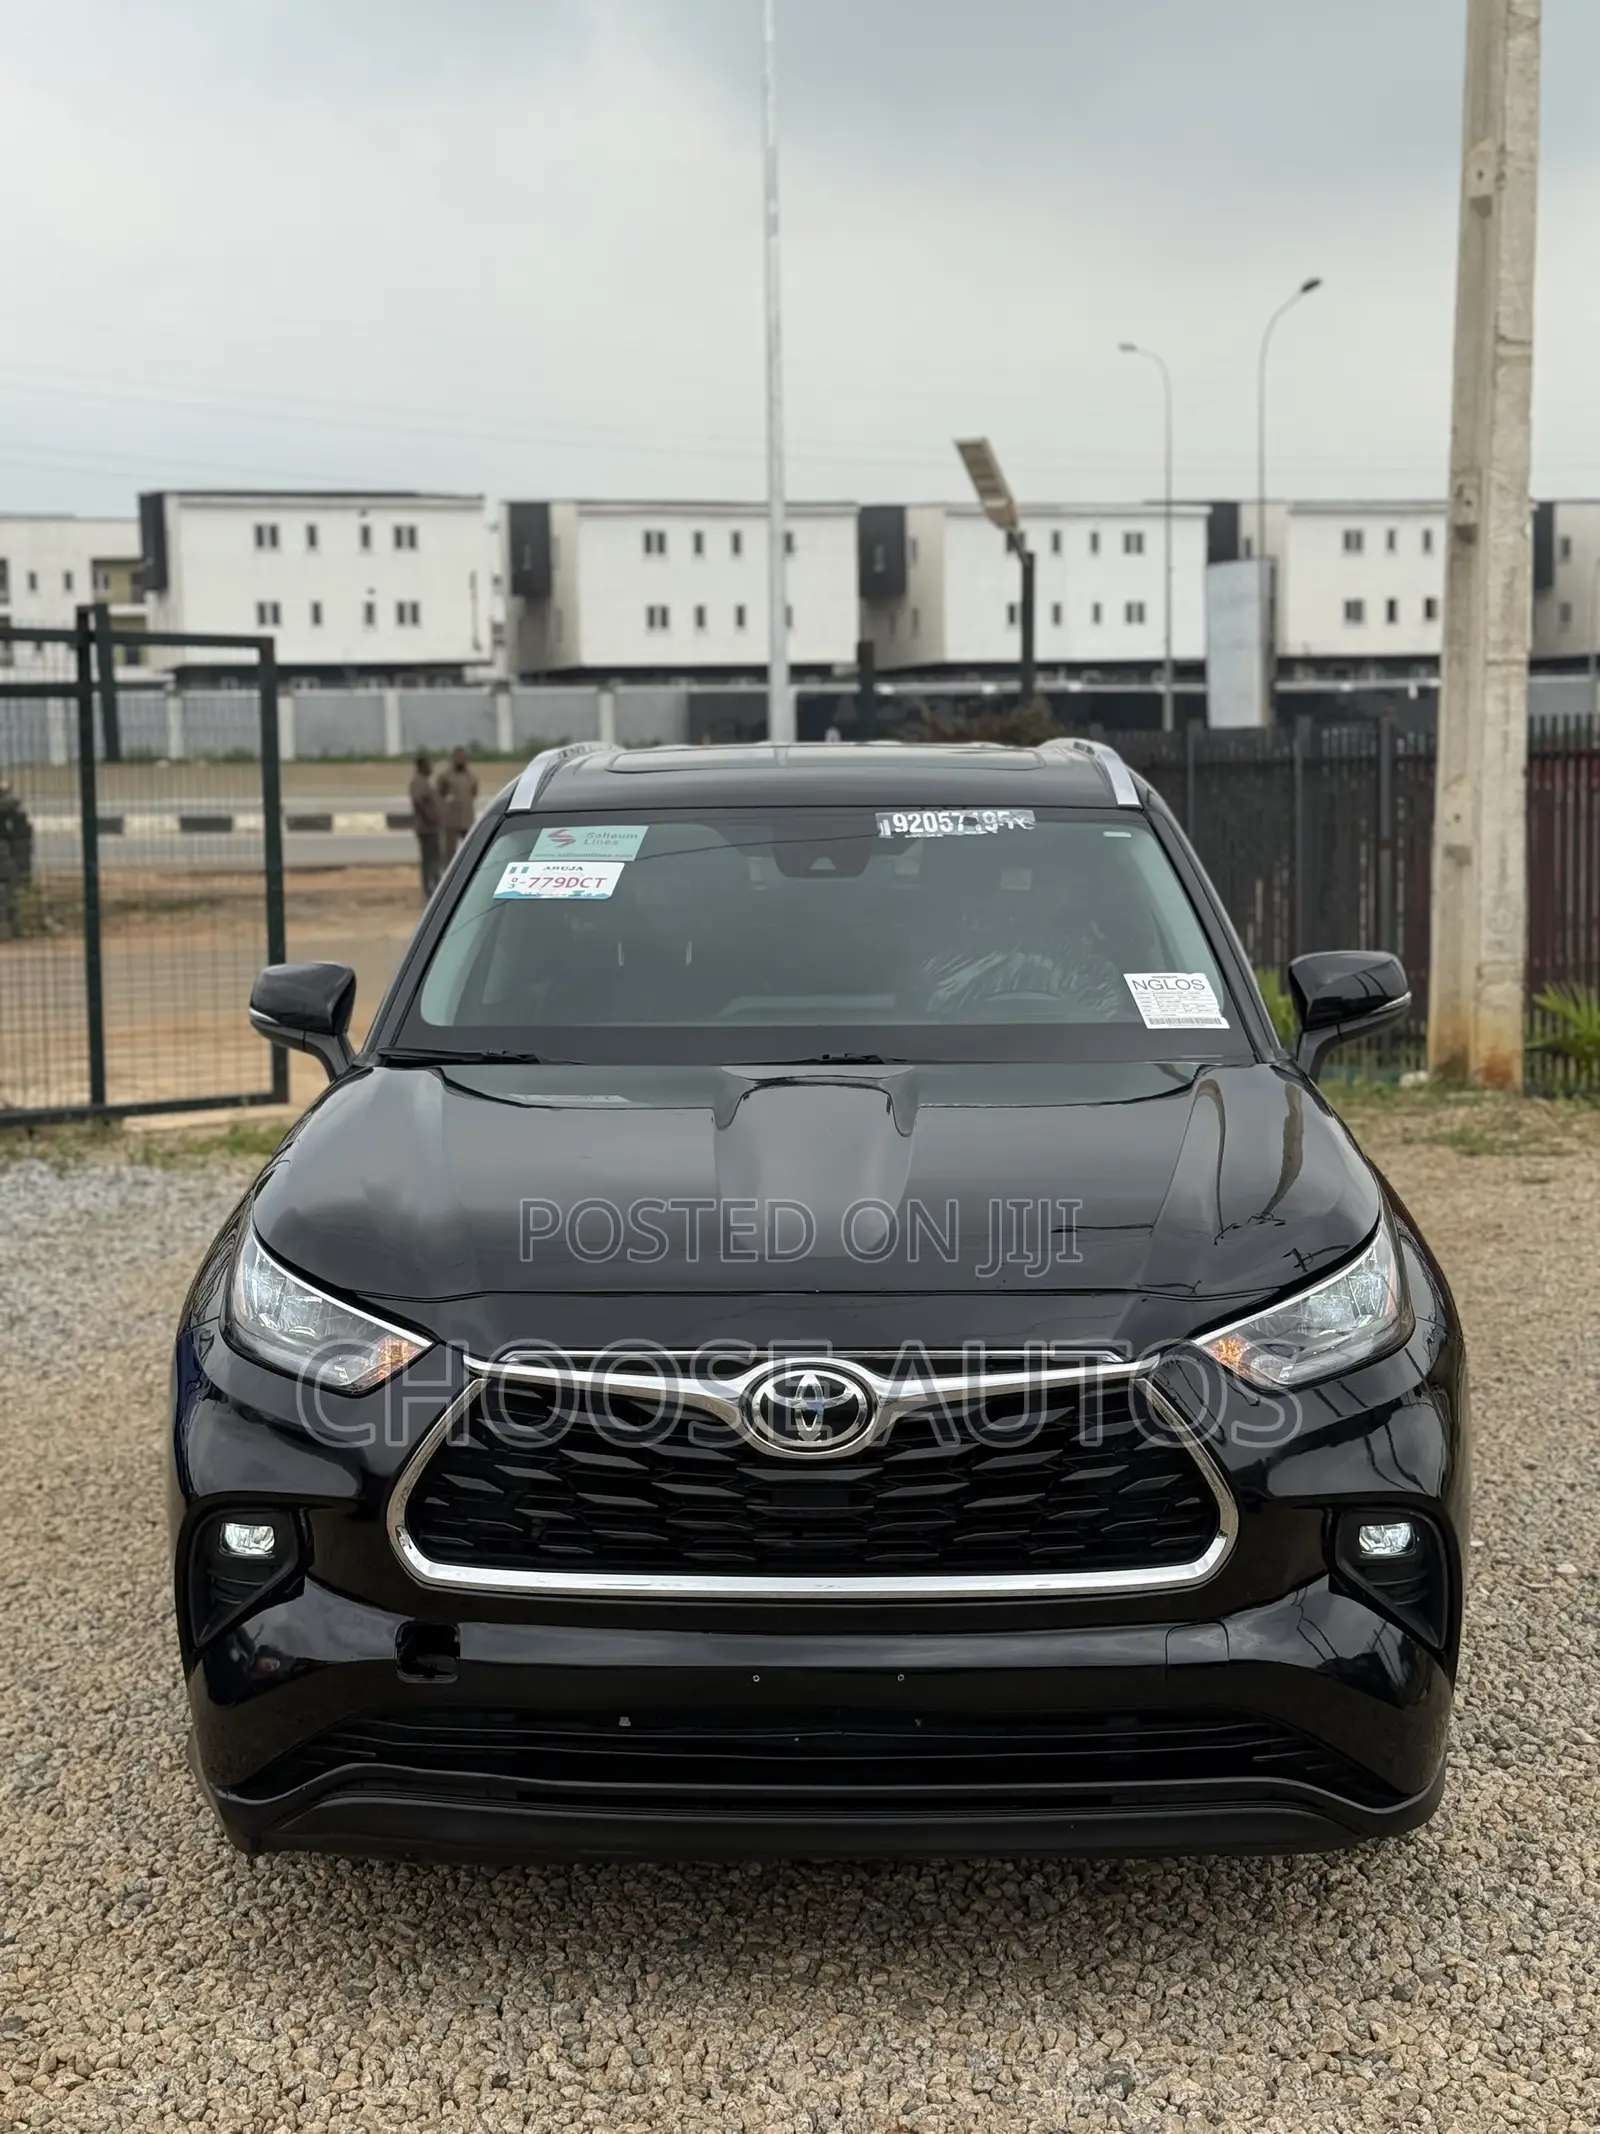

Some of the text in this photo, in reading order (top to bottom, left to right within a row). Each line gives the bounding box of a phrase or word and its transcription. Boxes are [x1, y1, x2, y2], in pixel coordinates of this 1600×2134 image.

[586, 832, 638, 840] Sallaum
[583, 838, 619, 846] Lines
[1132, 979, 1205, 991] NGLOS
